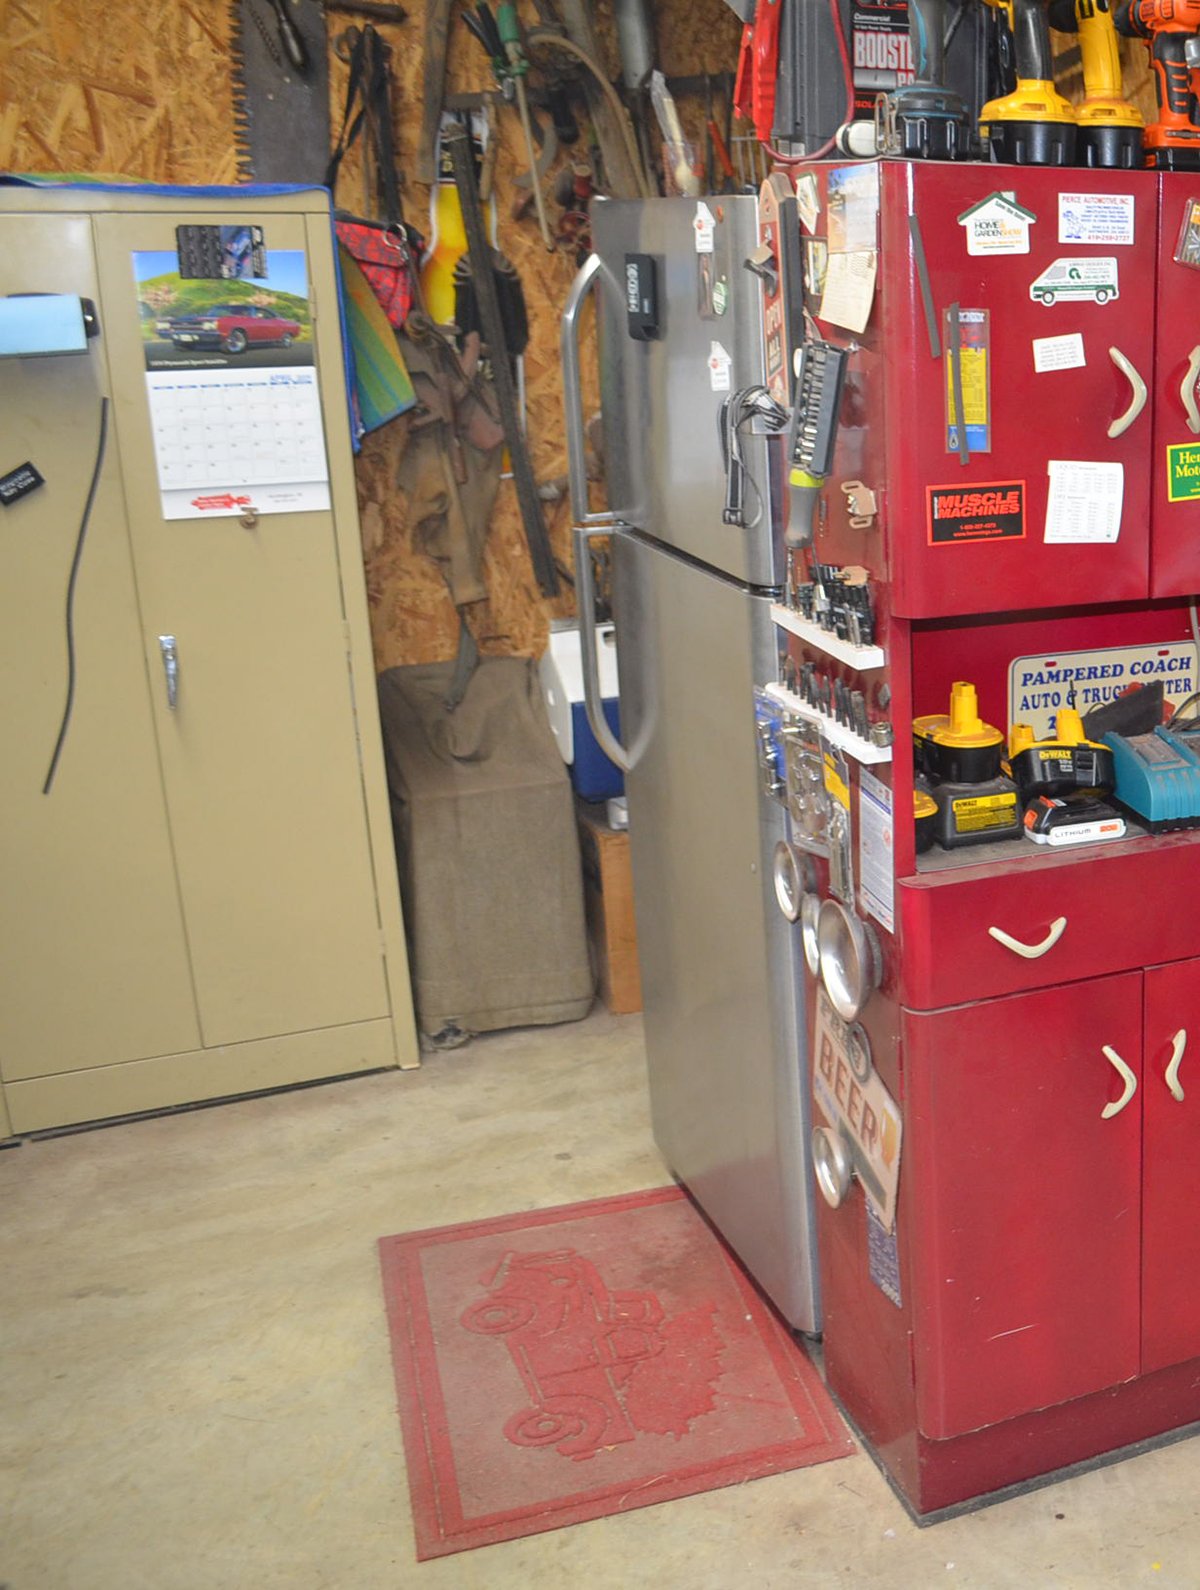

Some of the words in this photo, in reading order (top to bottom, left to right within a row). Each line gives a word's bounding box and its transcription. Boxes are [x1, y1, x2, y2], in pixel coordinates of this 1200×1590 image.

[854, 12, 891, 22] Commercial
[1062, 196, 1081, 204] PIERCE
[975, 222, 999, 230] HOME
[938, 491, 1020, 508] MUSCLE
[938, 503, 1020, 519] MACHINES
[1021, 664, 1124, 687] PAMPERED
[1130, 656, 1192, 675] COACH
[1020, 691, 1061, 711] AUTO
[1083, 684, 1129, 703] TRUC
[1055, 829, 1091, 838] LITHIUM
[820, 1031, 879, 1156] BEER
